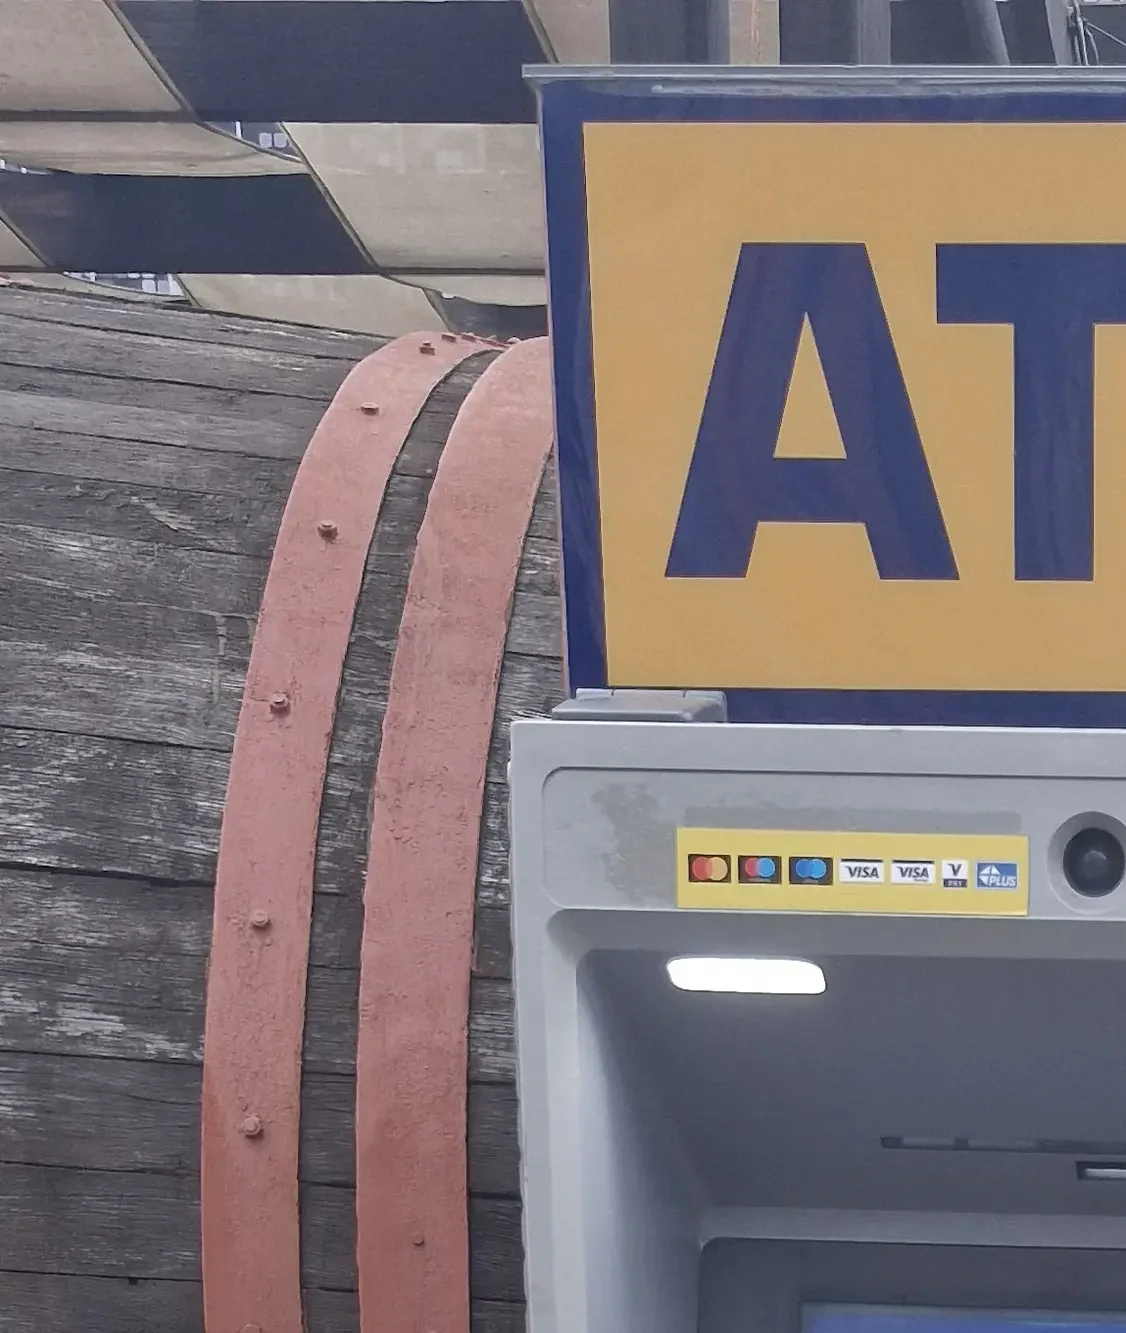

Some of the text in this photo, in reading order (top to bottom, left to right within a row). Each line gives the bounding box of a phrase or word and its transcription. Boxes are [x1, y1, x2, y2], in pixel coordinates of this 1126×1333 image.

[848, 866, 879, 879] VISA
[899, 866, 929, 879] VISA
[949, 863, 963, 876] V
[988, 873, 1016, 887] PLUS
